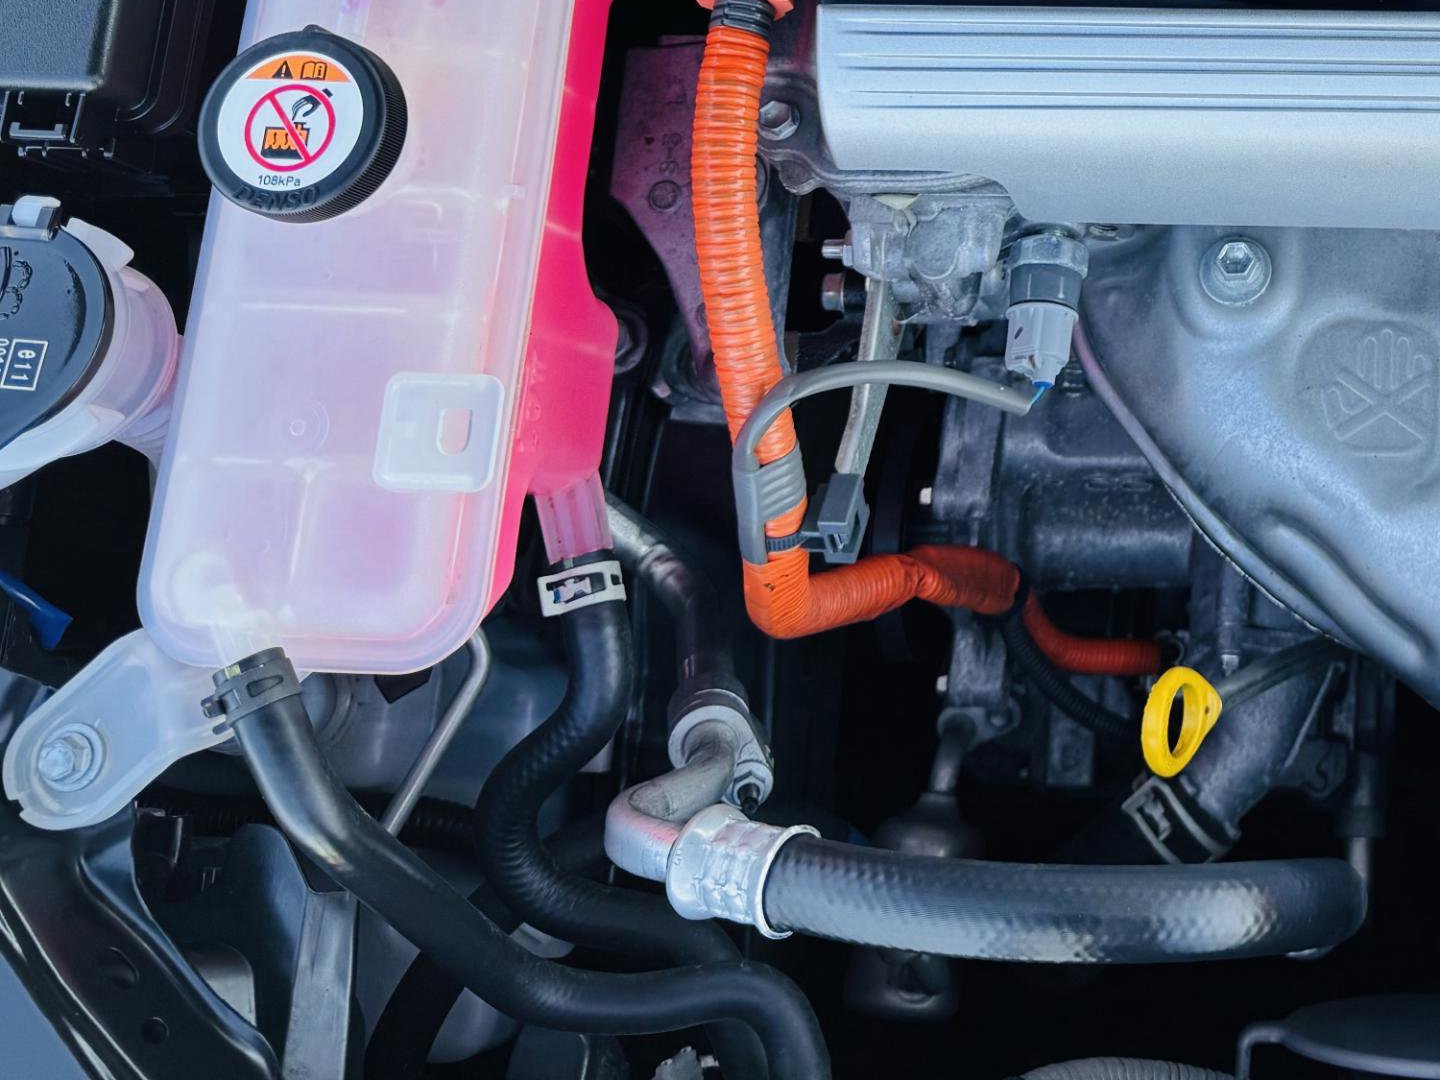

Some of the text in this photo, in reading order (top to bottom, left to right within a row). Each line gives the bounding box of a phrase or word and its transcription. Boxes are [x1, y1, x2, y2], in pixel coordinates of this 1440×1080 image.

[257, 174, 301, 187] 108kPa
[234, 185, 320, 211] DENSO
[11, 349, 36, 380] e11
